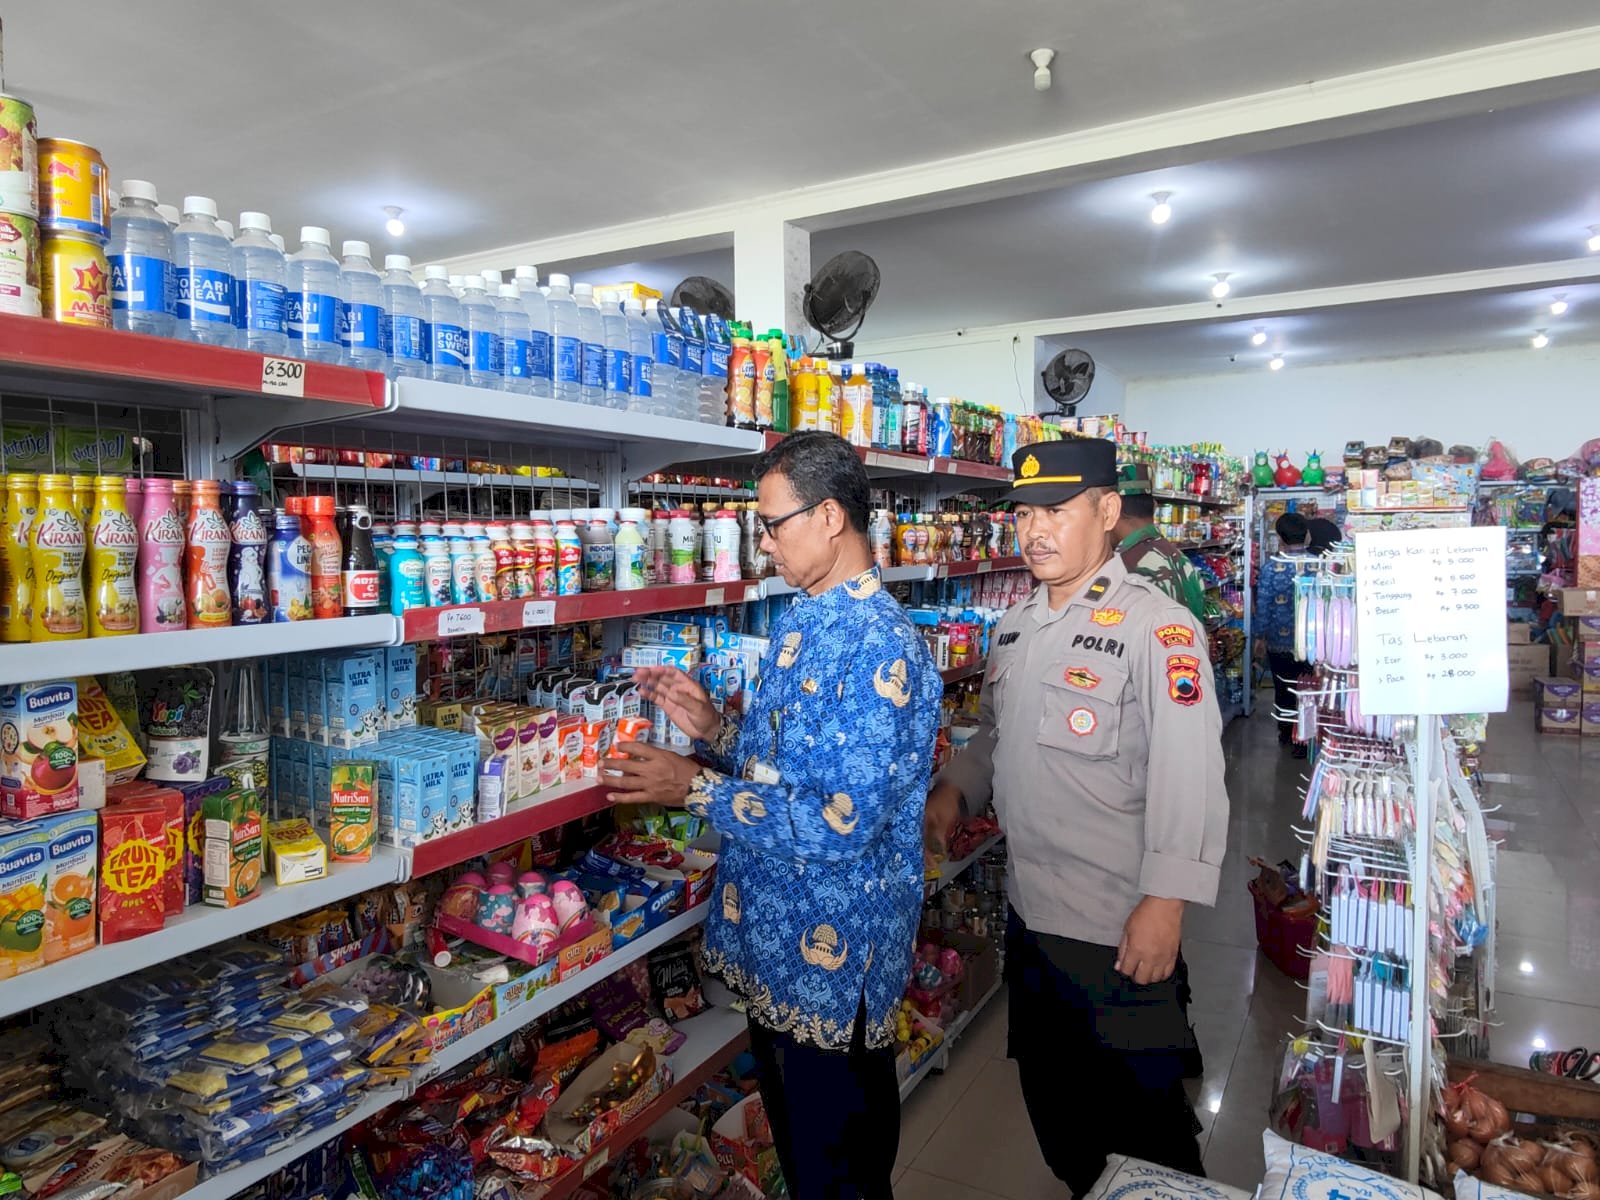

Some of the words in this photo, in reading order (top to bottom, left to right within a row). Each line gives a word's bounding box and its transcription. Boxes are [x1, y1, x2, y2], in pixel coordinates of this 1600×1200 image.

[1368, 545, 1401, 560] Harga
[1372, 577, 1396, 587] Kecil
[1071, 634, 1124, 658] POLRI
[1376, 633, 1403, 646] Tas
[1413, 631, 1468, 644] Lebaran
[29, 691, 71, 709] Buavita
[333, 792, 369, 804] NutriSari
[52, 833, 92, 856] Buavita
[110, 845, 159, 869] FRUIT
[110, 867, 157, 888] TEA
